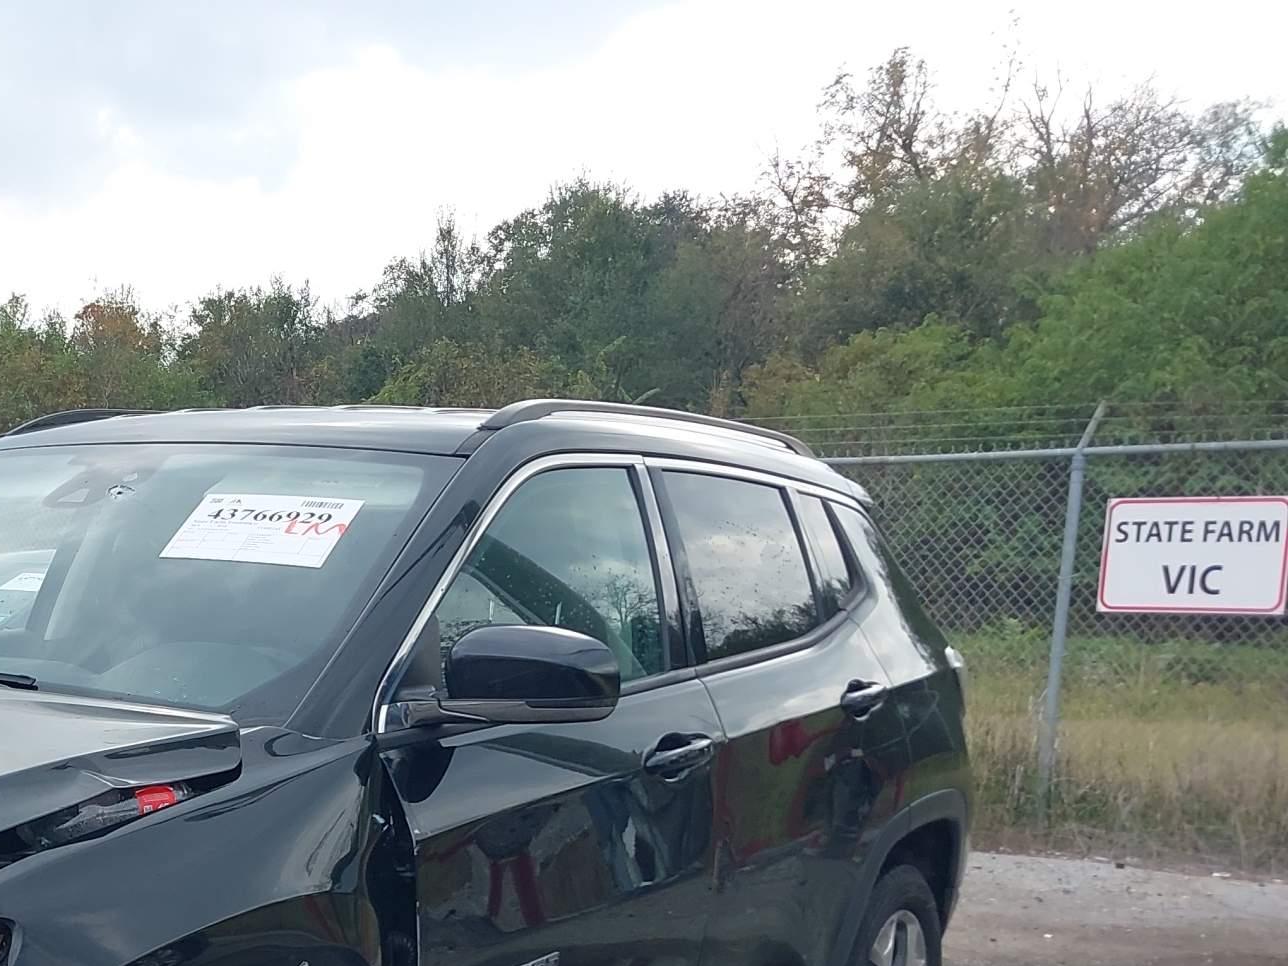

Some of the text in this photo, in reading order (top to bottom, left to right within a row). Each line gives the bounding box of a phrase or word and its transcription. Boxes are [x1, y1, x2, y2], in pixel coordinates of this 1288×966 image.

[207, 507, 333, 525] 43766929
[1114, 519, 1281, 543] STATE FARM
[1162, 564, 1224, 595] VIC
